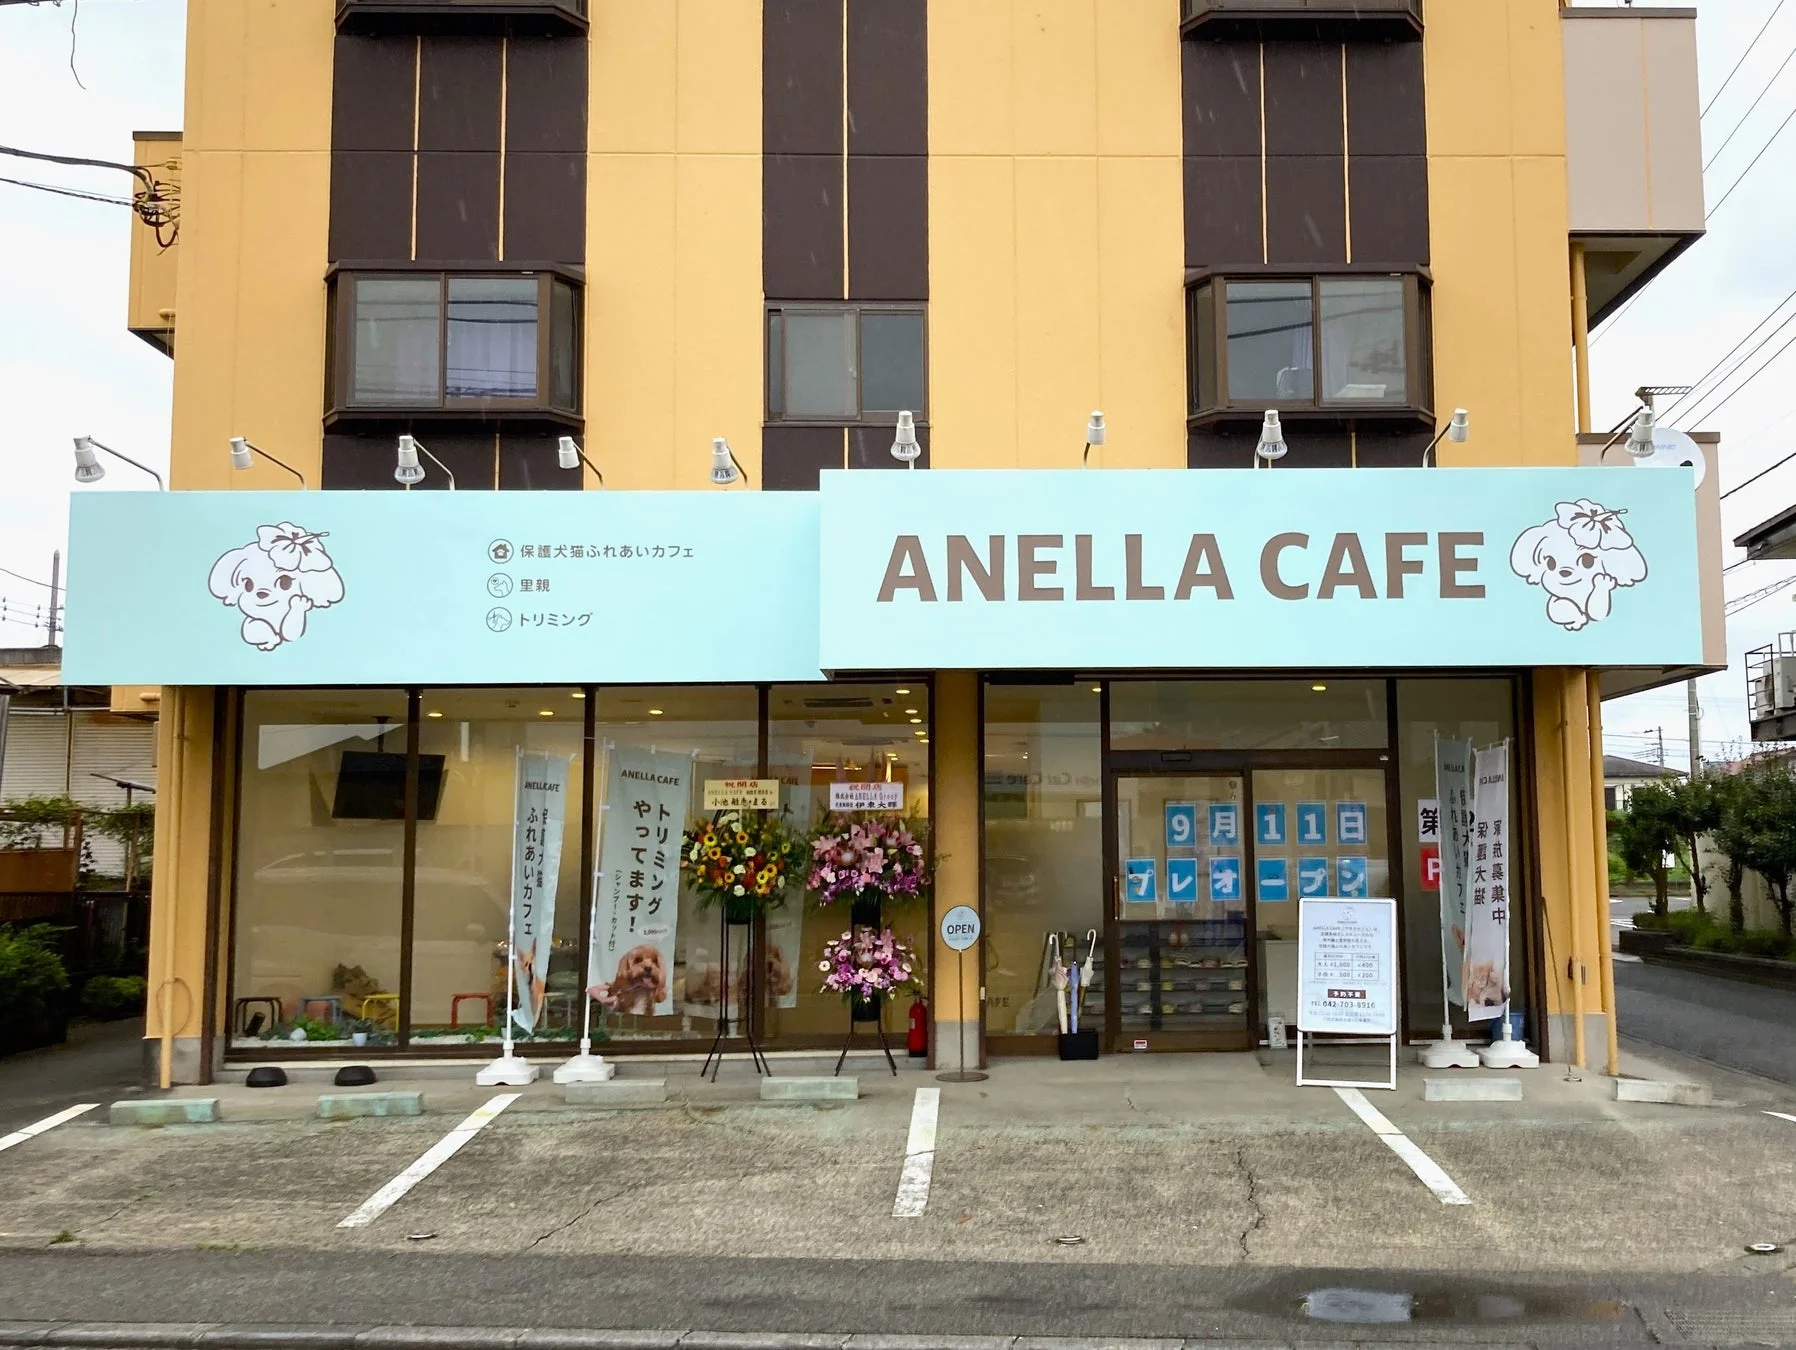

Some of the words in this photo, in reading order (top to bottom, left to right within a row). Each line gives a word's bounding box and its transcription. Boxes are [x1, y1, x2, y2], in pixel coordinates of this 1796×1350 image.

[520, 544, 694, 559] 保護犬猫ふれあいカフェ
[876, 534, 1235, 602] ANELLA
[1260, 532, 1486, 600] CAFE
[520, 579, 551, 592] 里親
[520, 612, 594, 627] トリミング
[621, 769, 656, 783] ANELLA
[657, 774, 679, 786] CAFE
[724, 781, 759, 789] 祝開店
[1172, 803, 1365, 842] 9月11日
[626, 799, 651, 934] やってます!
[648, 803, 671, 915] トリミング
[523, 807, 539, 936] ふれあいカフェ
[1127, 868, 1365, 897] プレオープン
[947, 924, 975, 935] OPEN
